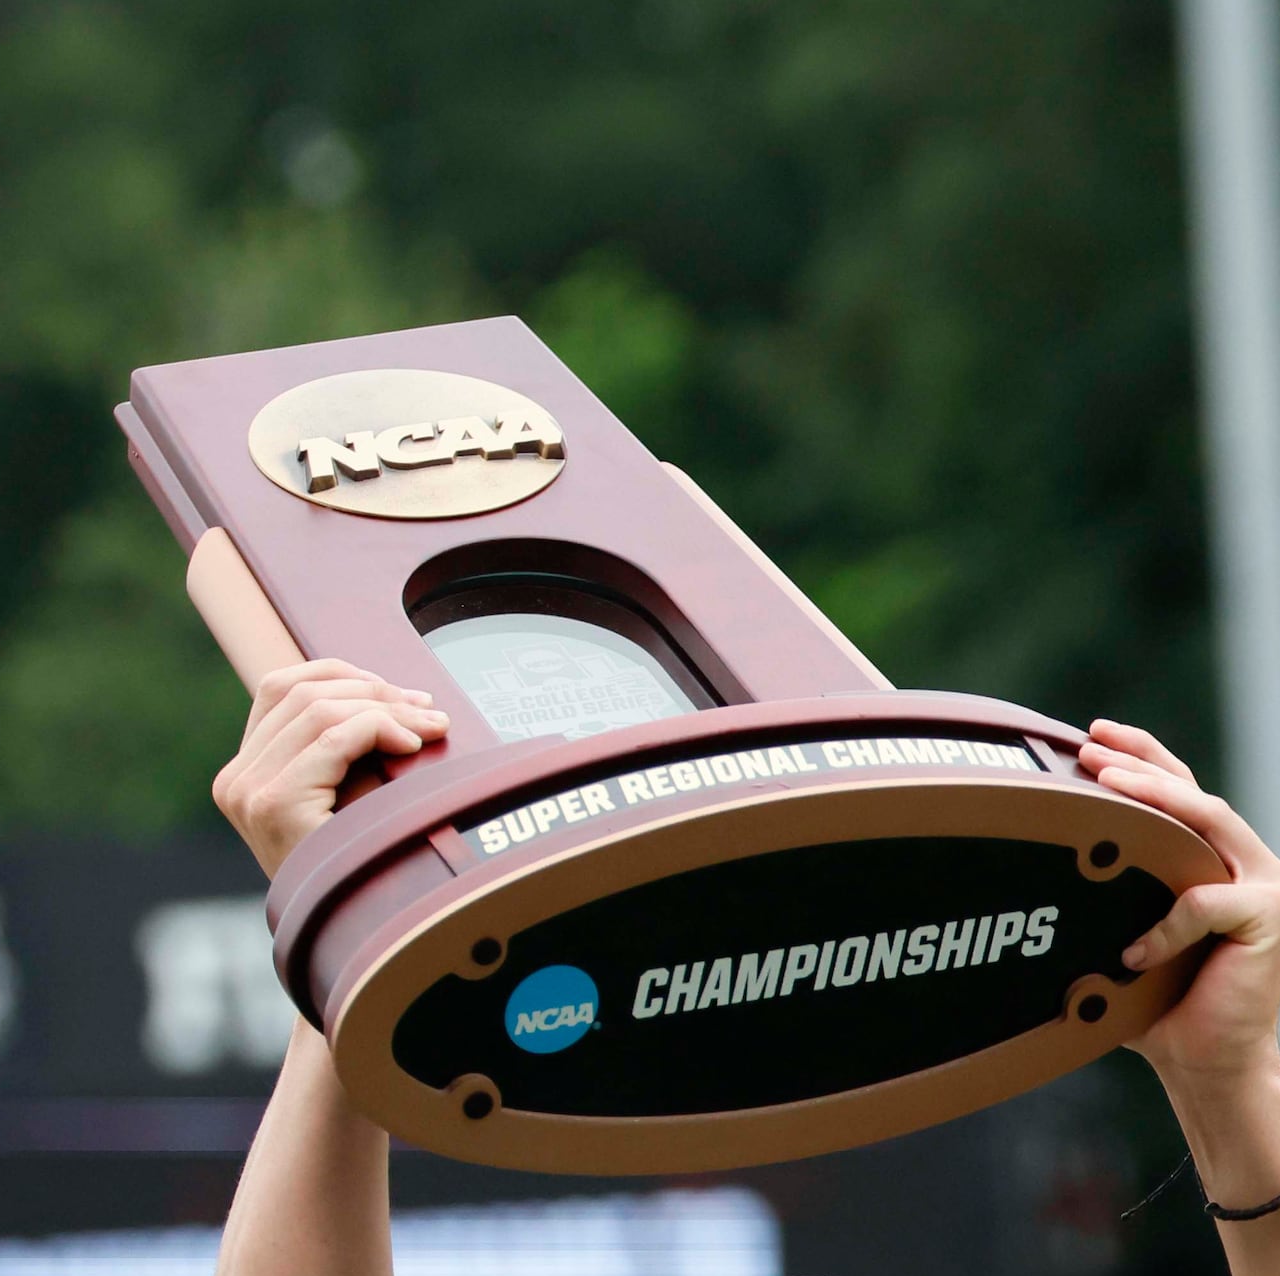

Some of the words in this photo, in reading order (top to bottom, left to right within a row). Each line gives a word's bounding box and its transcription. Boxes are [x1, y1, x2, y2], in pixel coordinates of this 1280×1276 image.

[297, 408, 566, 492] NCAA
[493, 703, 577, 728] WORLD
[583, 691, 665, 715] SERIES
[520, 684, 619, 710] COLLEGE
[477, 782, 616, 855] SUPER
[618, 744, 818, 805] REGIONAL
[821, 738, 1032, 771] CHAMPION
[514, 1002, 595, 1036] NCAA
[631, 905, 1059, 1020] CHAMPIONSHIPS
